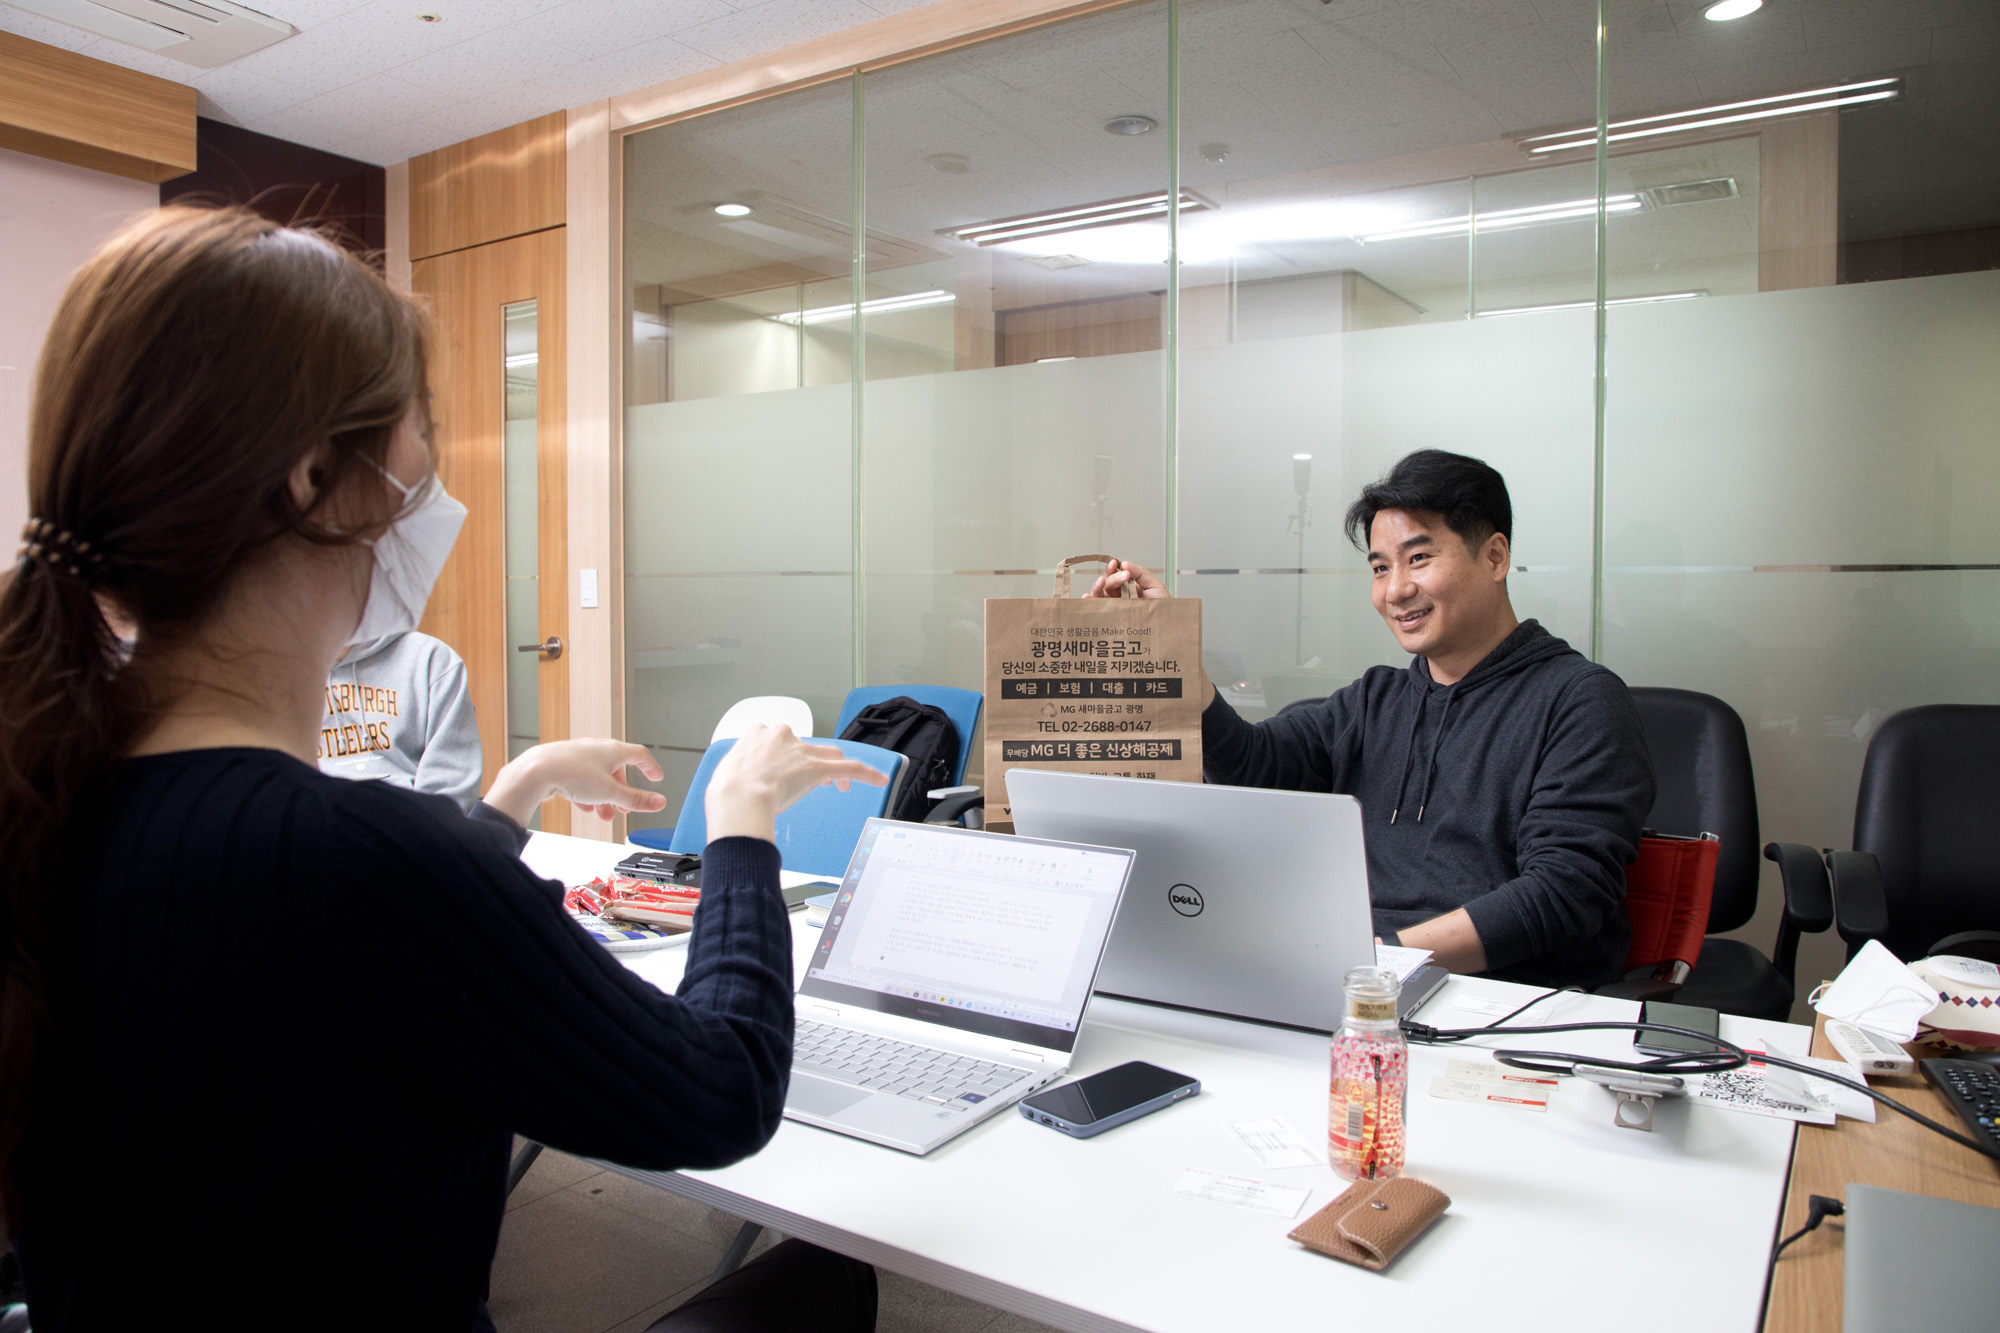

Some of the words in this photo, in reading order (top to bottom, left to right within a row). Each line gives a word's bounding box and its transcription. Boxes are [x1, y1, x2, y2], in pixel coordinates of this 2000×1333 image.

[1030, 627, 1064, 638] 대한민국
[1066, 627, 1099, 638] 생활금융
[1101, 627, 1125, 636] Make
[1127, 627, 1152, 636] Good!
[1002, 661, 1036, 675] 당신의
[1038, 661, 1072, 675] 소중한
[1074, 660, 1109, 675] 내일을
[1110, 660, 1181, 675] 지키겠습니다.
[1015, 682, 1038, 695] 예금
[1058, 682, 1081, 695] 보험
[1102, 681, 1125, 695] 대출
[1146, 681, 1168, 694] 카드
[1060, 705, 1076, 714] MG
[1078, 704, 1123, 715] 새마을금고
[1125, 704, 1144, 715] 광명
[1036, 720, 1060, 733] TEL
[1062, 720, 1152, 733] 02-2688-0147
[1006, 749, 1029, 758] 무배당
[1031, 744, 1054, 757] MG
[1057, 743, 1071, 758] 더
[1075, 743, 1102, 759] 좋은
[1106, 742, 1173, 759] 신상해공제
[1172, 894, 1201, 907] DELL
